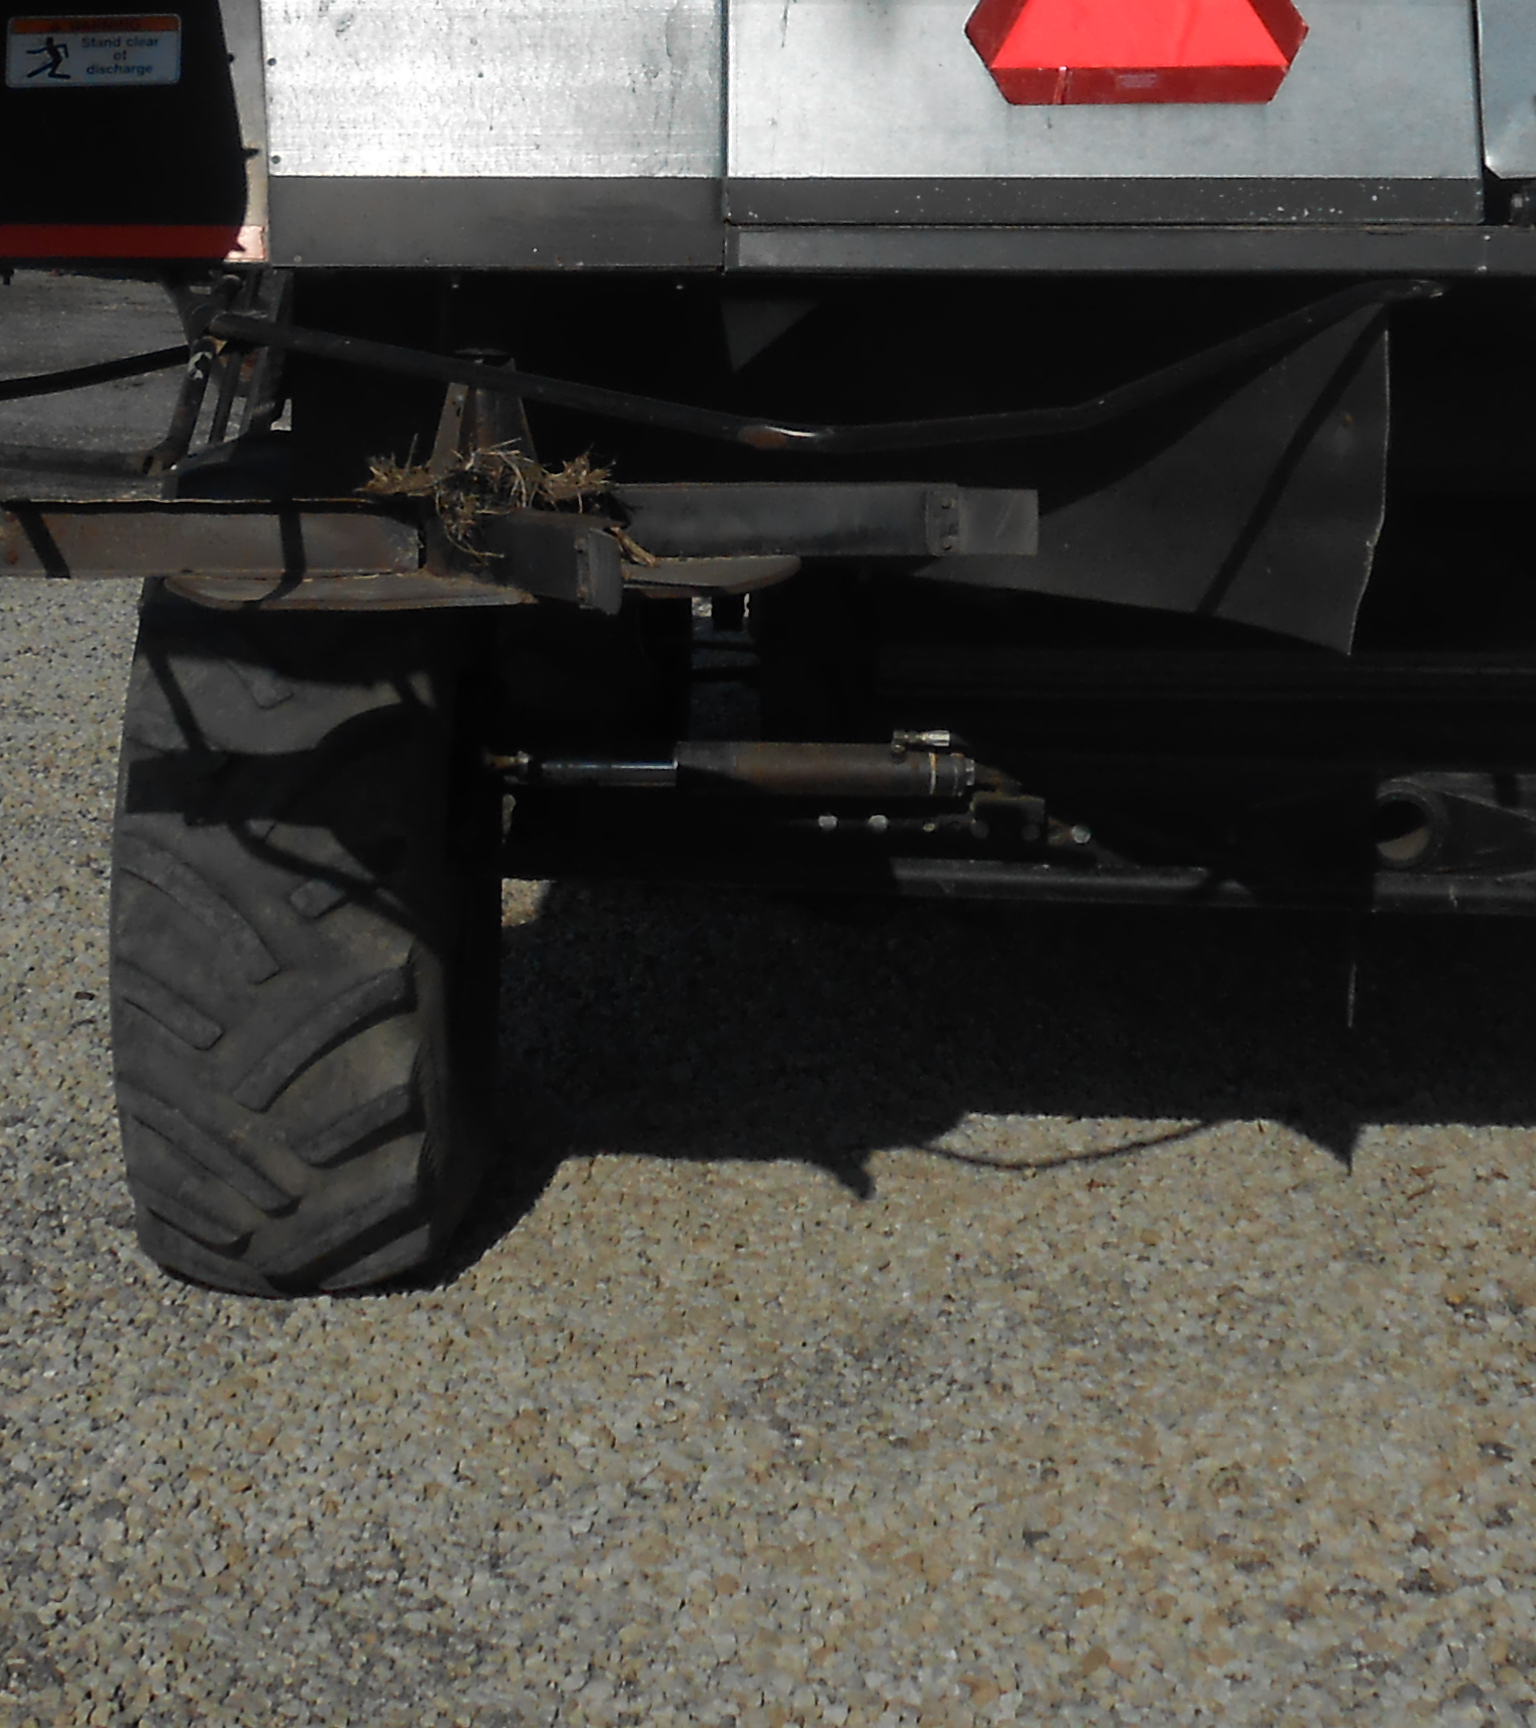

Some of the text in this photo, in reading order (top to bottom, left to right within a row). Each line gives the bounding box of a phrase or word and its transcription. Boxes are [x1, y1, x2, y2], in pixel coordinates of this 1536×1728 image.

[81, 36, 159, 48] Stand clear
[113, 50, 127, 61] of
[86, 63, 153, 76] discharge
